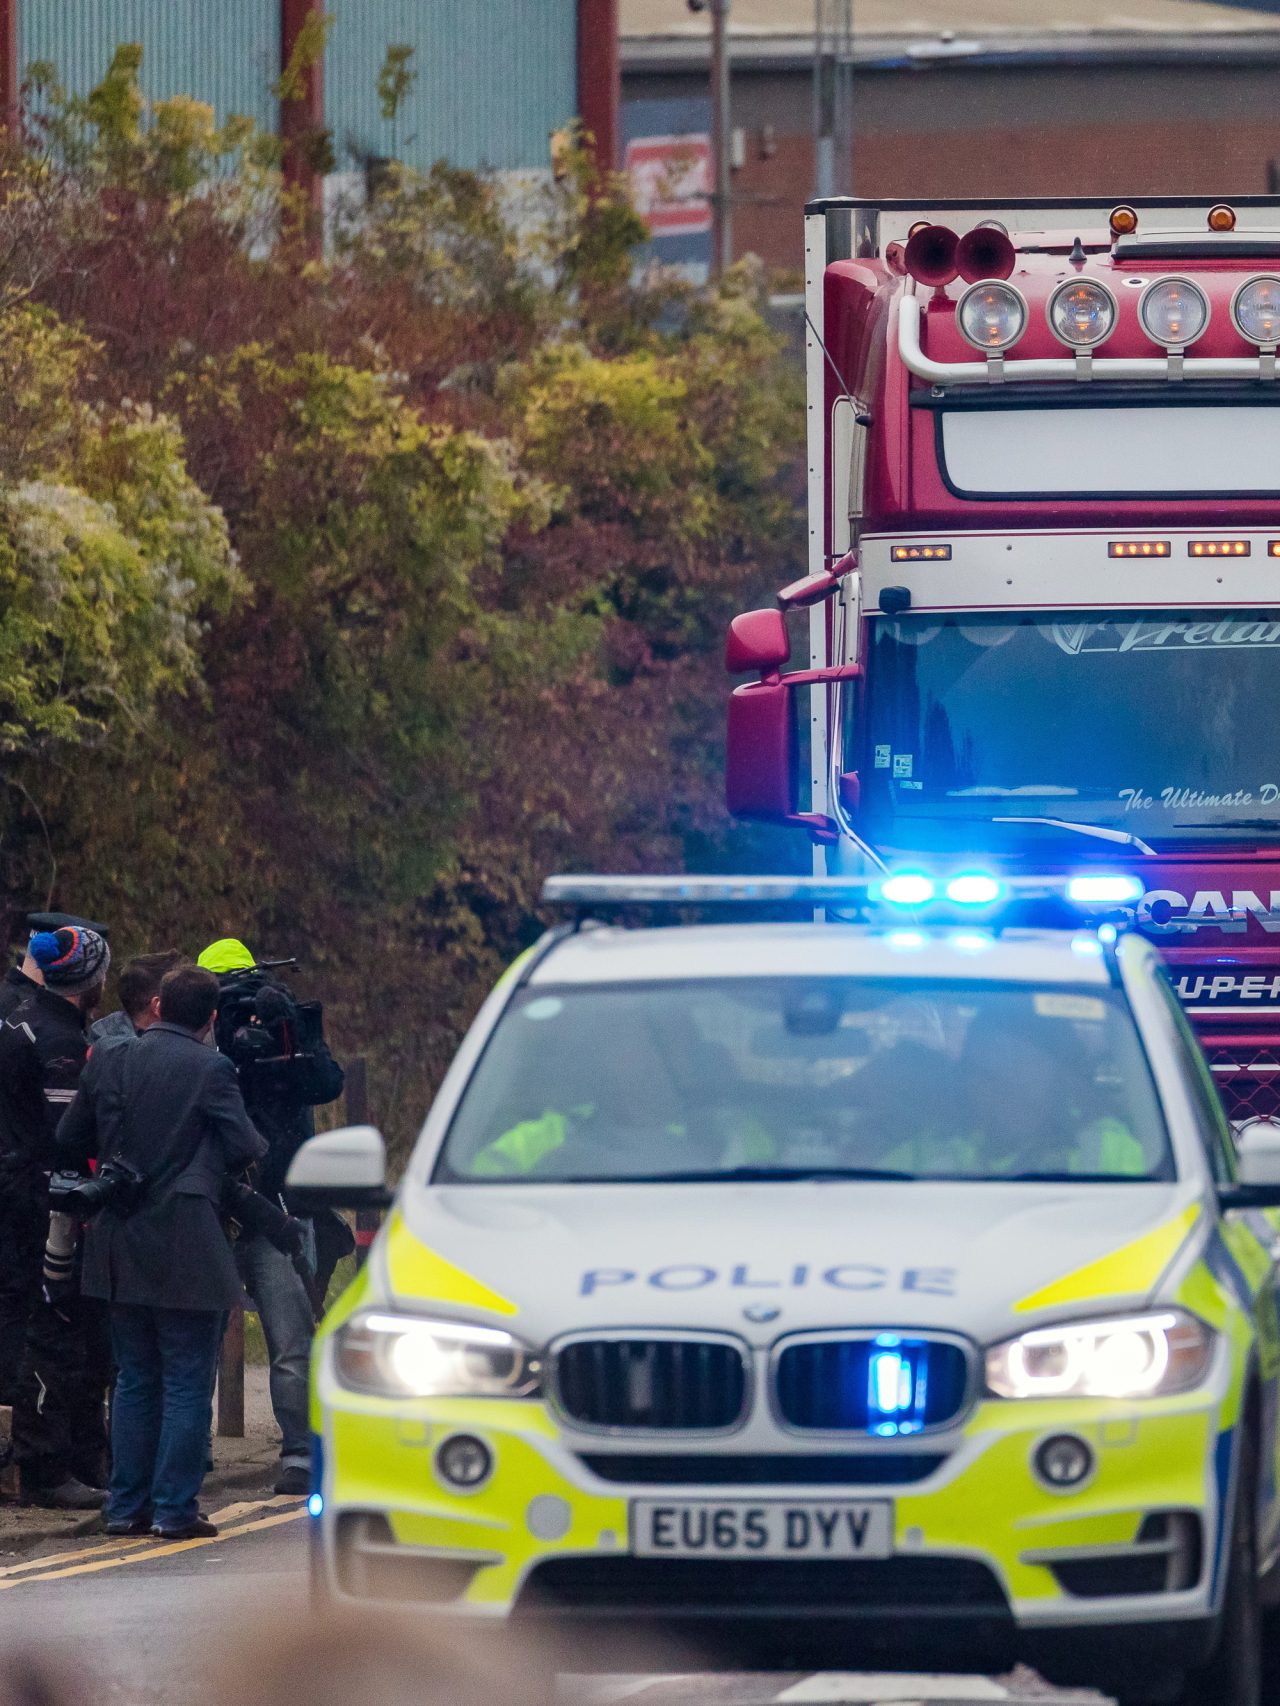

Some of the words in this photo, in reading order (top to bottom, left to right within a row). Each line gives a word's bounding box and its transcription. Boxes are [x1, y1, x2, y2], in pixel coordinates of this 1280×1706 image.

[1118, 788, 1153, 811] The
[1160, 786, 1253, 809] Ultimate
[579, 1263, 958, 1297] POLICE
[651, 1507, 769, 1550] EU65
[784, 1508, 871, 1550] DYV
